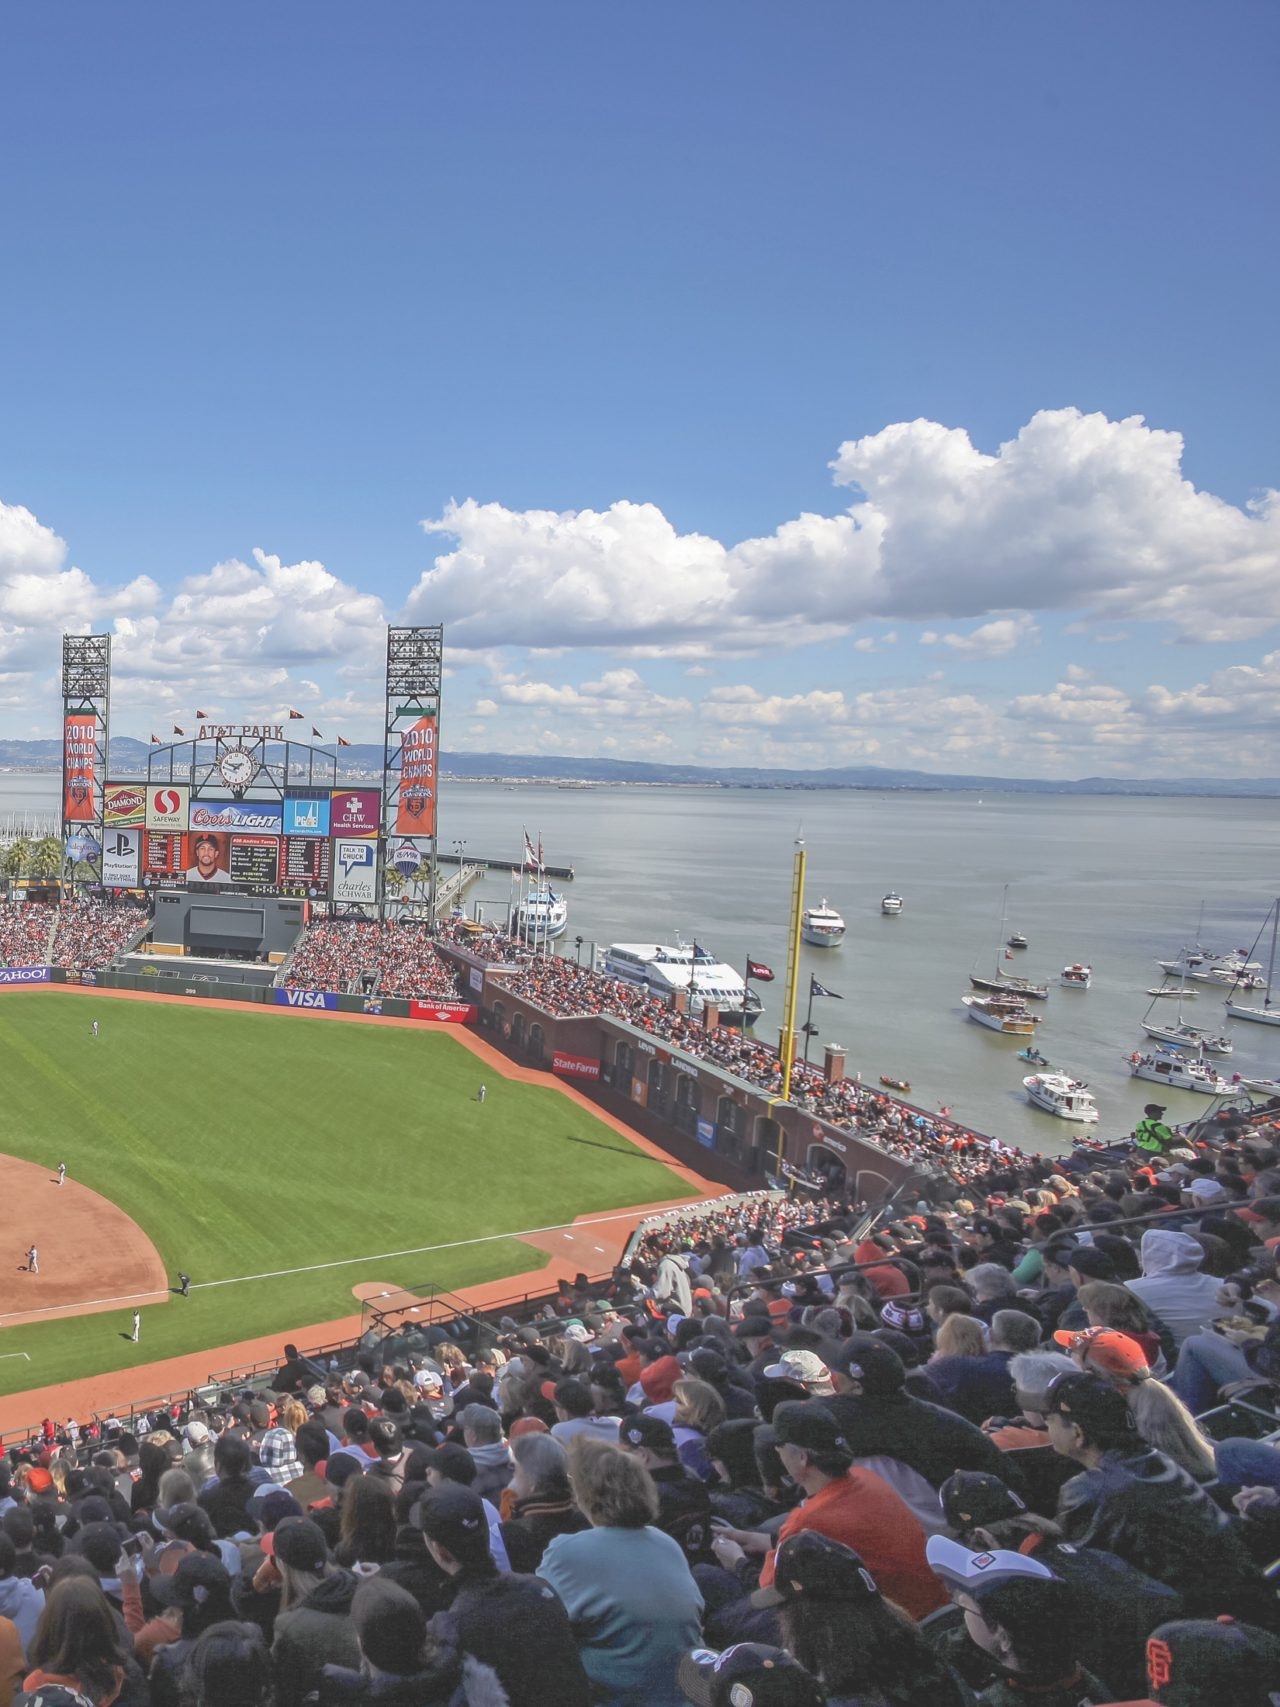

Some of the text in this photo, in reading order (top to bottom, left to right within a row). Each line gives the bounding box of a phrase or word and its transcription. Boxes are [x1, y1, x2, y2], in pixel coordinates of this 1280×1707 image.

[66, 725, 94, 740] 2010
[199, 725, 284, 740] AT&T PARK
[404, 728, 433, 747] 2010
[66, 743, 94, 755] WORLD
[404, 748, 433, 763] WORLD
[66, 758, 93, 770] CHAMPS
[403, 764, 433, 779] CHAMPS
[108, 796, 143, 810] DIAMOND
[192, 808, 278, 828] Coors LIGHT
[342, 813, 366, 822] CHW
[338, 881, 371, 892] charles
[337, 890, 372, 899] SCHWAB
[287, 991, 325, 1008] VISA
[418, 1001, 434, 1009] Bank
[441, 1004, 469, 1012] America
[553, 1057, 599, 1075] State Farm
[1146, 1638, 1173, 1690] SF
